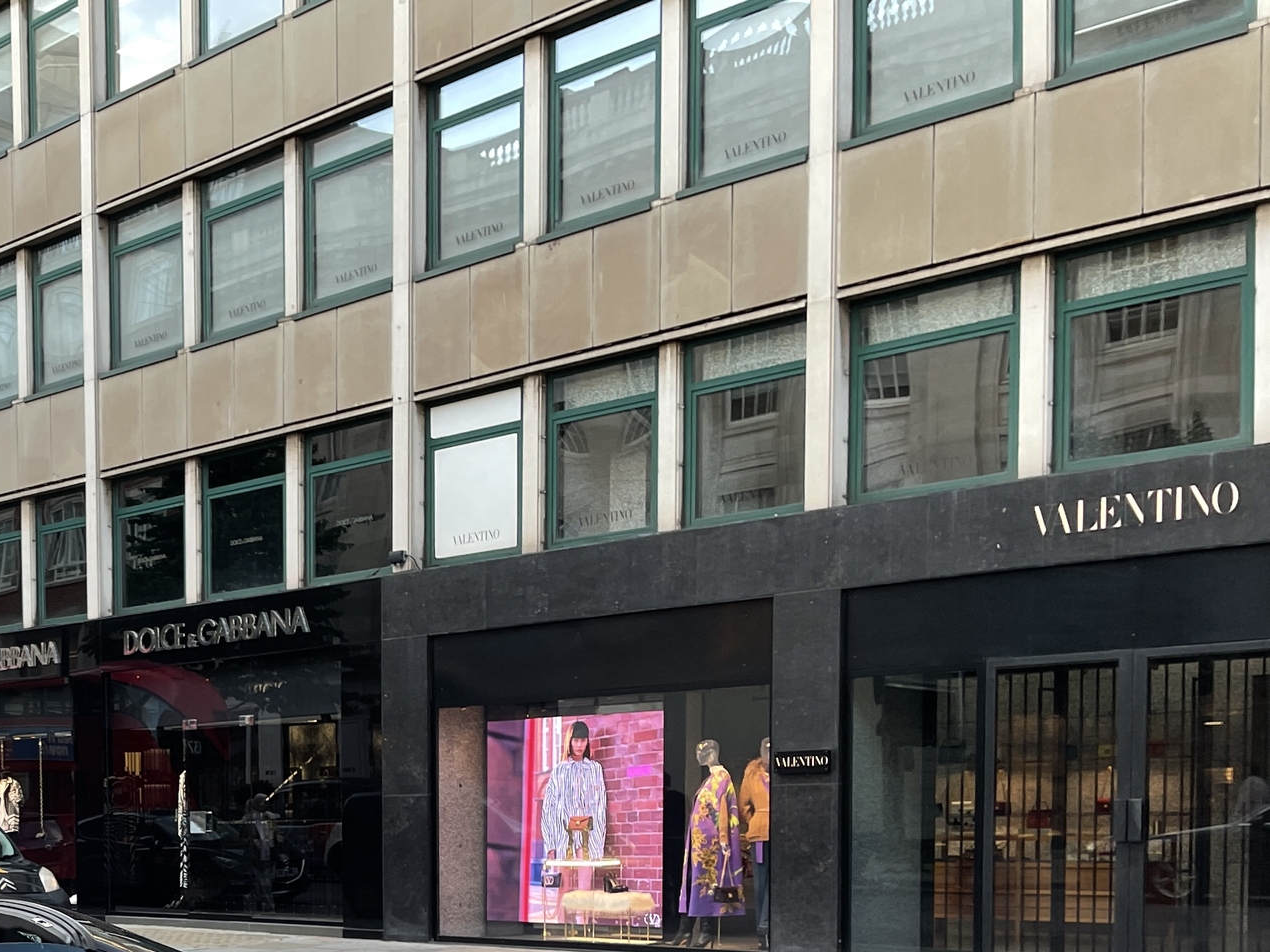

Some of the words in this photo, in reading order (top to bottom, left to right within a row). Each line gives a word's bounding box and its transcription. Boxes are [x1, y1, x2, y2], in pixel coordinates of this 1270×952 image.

[903, 70, 976, 102] VALENTINO
[723, 130, 787, 160] VALENTINO
[579, 179, 636, 205] VALENTINO
[455, 222, 504, 245] VALENTINO
[335, 263, 378, 284] VALENTINO
[228, 300, 267, 318] VALENTINO
[133, 331, 168, 349] VALENTINO
[1033, 480, 1240, 536] VALENTINO
[452, 528, 501, 546] VALENTINO
[775, 755, 829, 768] VALENTINO
